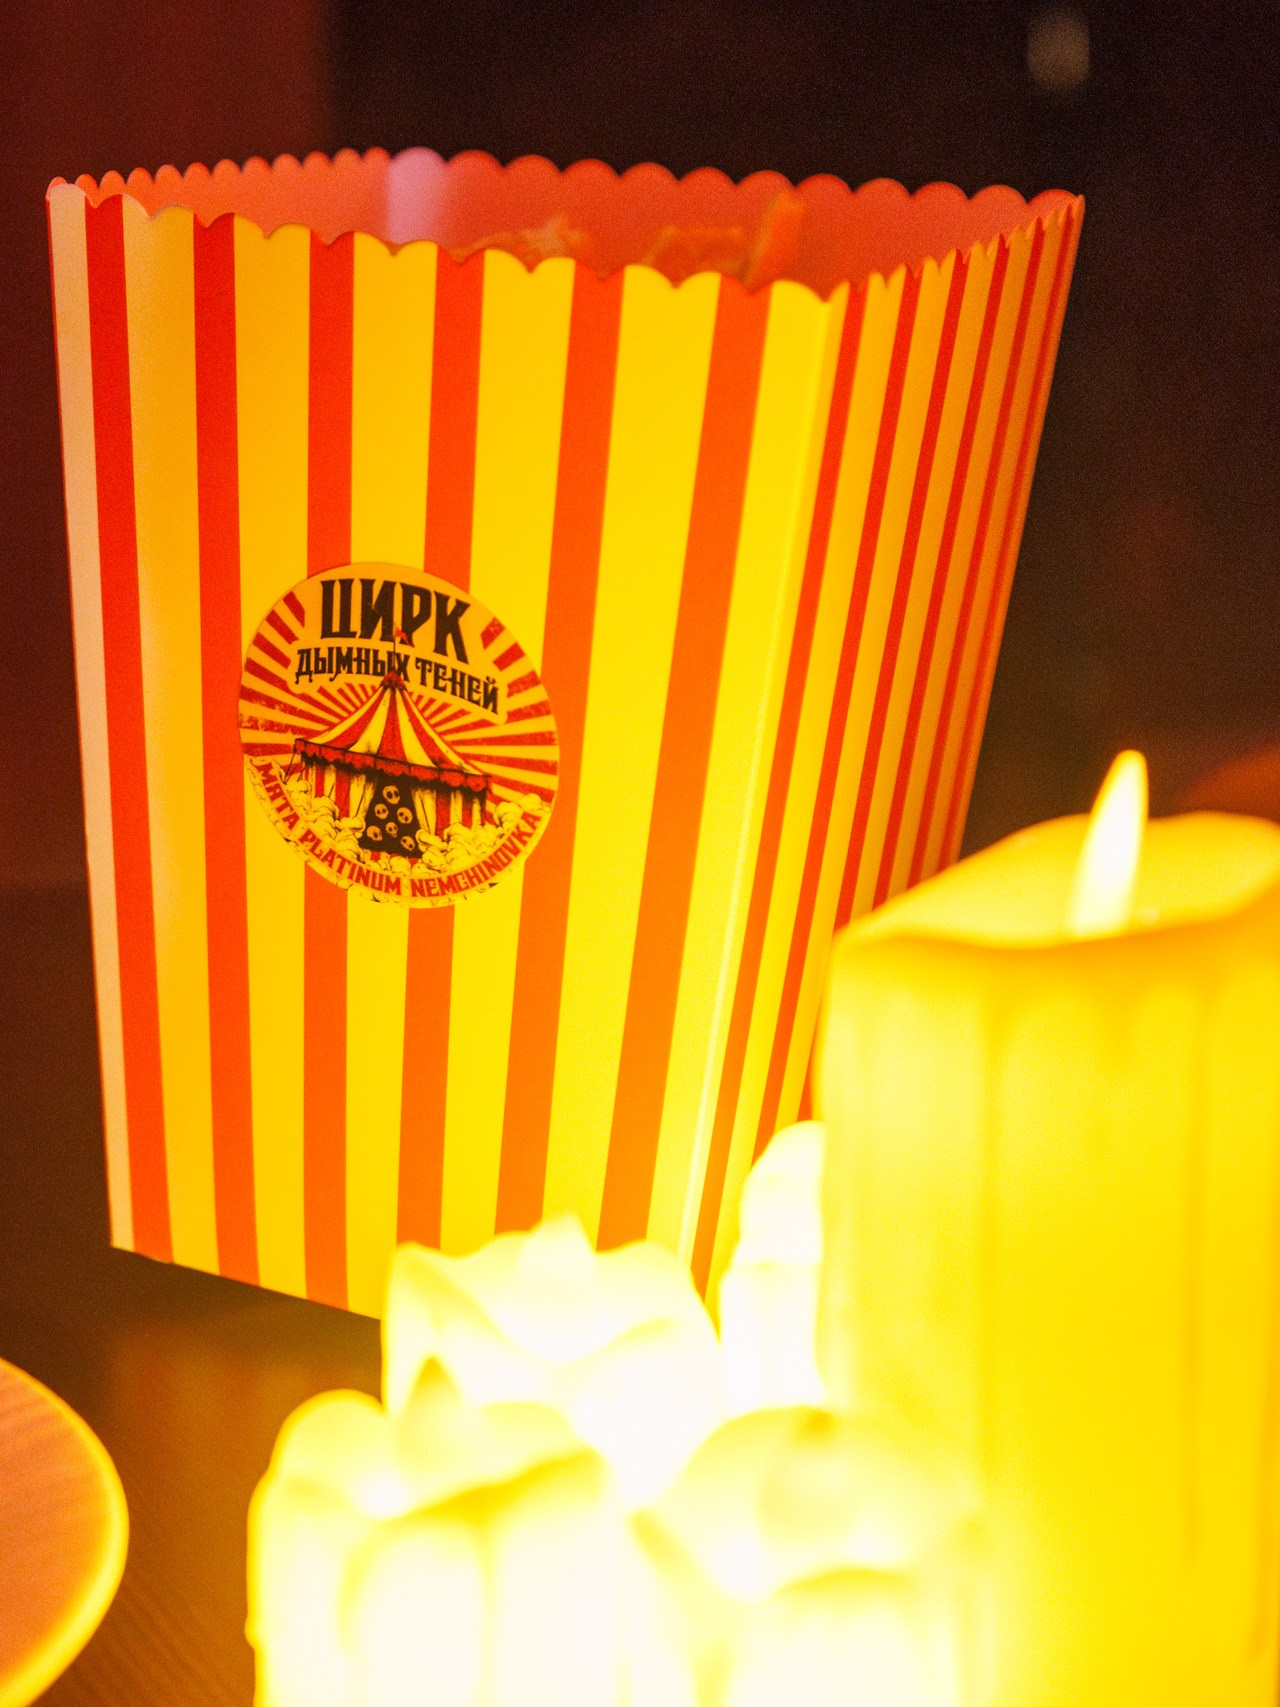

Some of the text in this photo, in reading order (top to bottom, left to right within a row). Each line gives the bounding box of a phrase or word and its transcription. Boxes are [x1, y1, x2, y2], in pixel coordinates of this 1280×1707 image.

[320, 578, 470, 664] ЦИРК
[294, 647, 500, 715] ДЫМНЫХ ТЕНЕЙ
[250, 759, 543, 898] МЯТА PLATINUM NEMCHINOVKA
